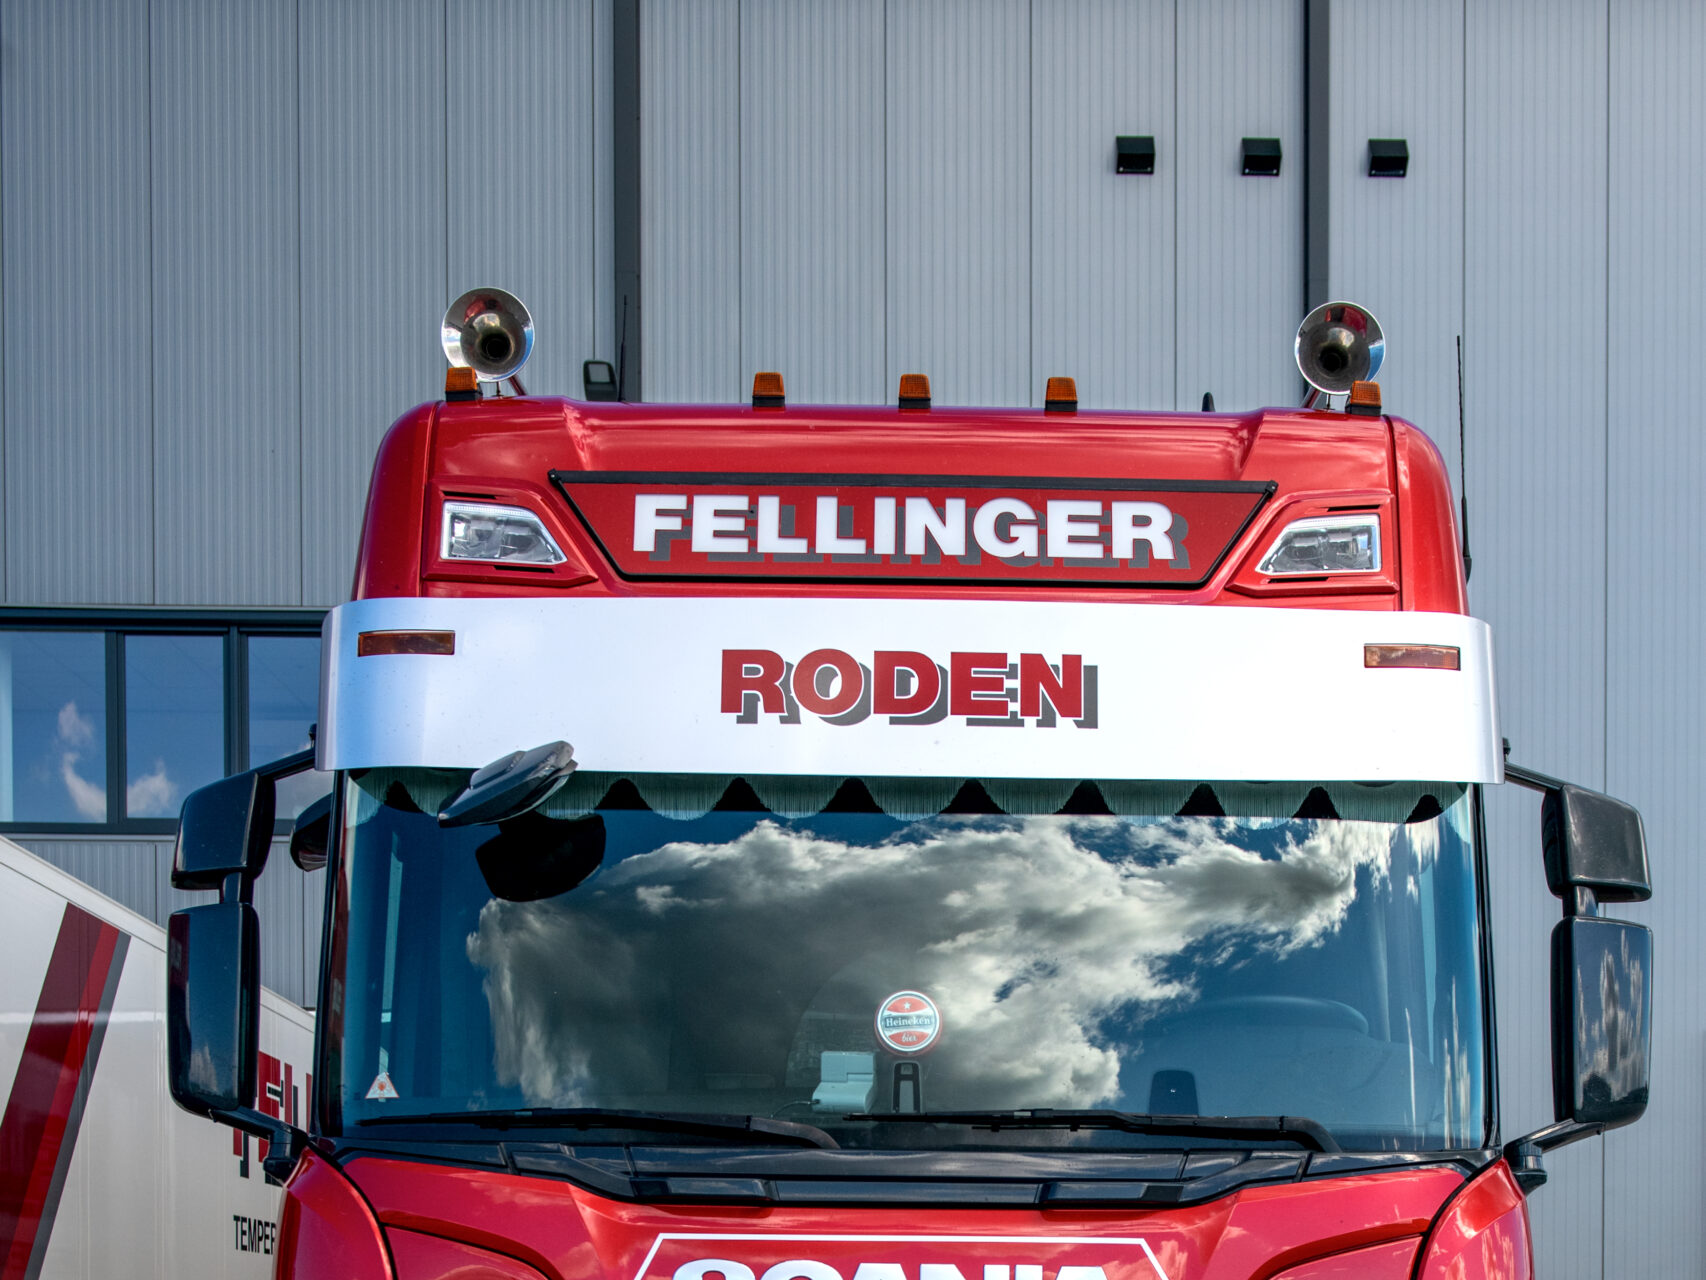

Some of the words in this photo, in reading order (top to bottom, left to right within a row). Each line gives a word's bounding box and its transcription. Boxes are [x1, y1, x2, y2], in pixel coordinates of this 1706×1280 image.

[633, 493, 1177, 560] FELLINGER
[720, 648, 1084, 719] RODEN
[885, 1016, 931, 1028] Heineken
